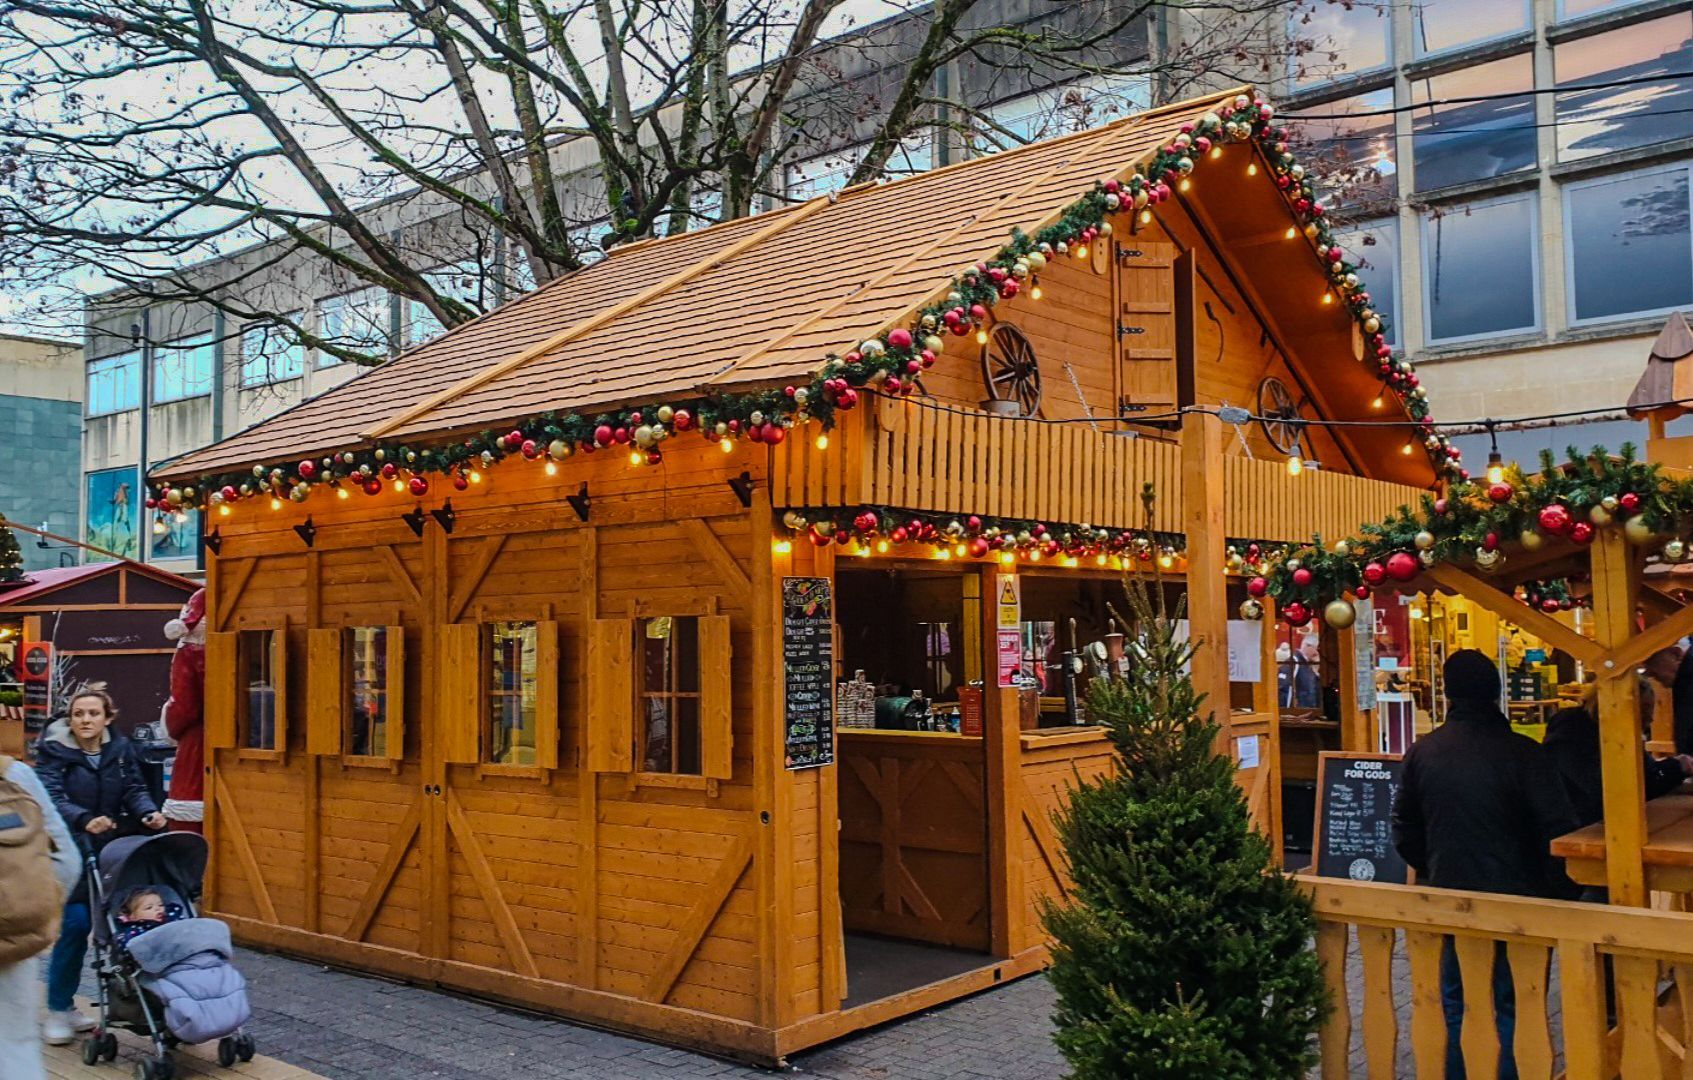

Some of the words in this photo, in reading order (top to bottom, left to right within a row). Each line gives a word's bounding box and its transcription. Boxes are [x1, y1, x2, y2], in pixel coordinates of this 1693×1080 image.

[1354, 761, 1383, 769] CIDER
[1344, 769, 1364, 778] FOR
[1365, 771, 1392, 780] GODS
